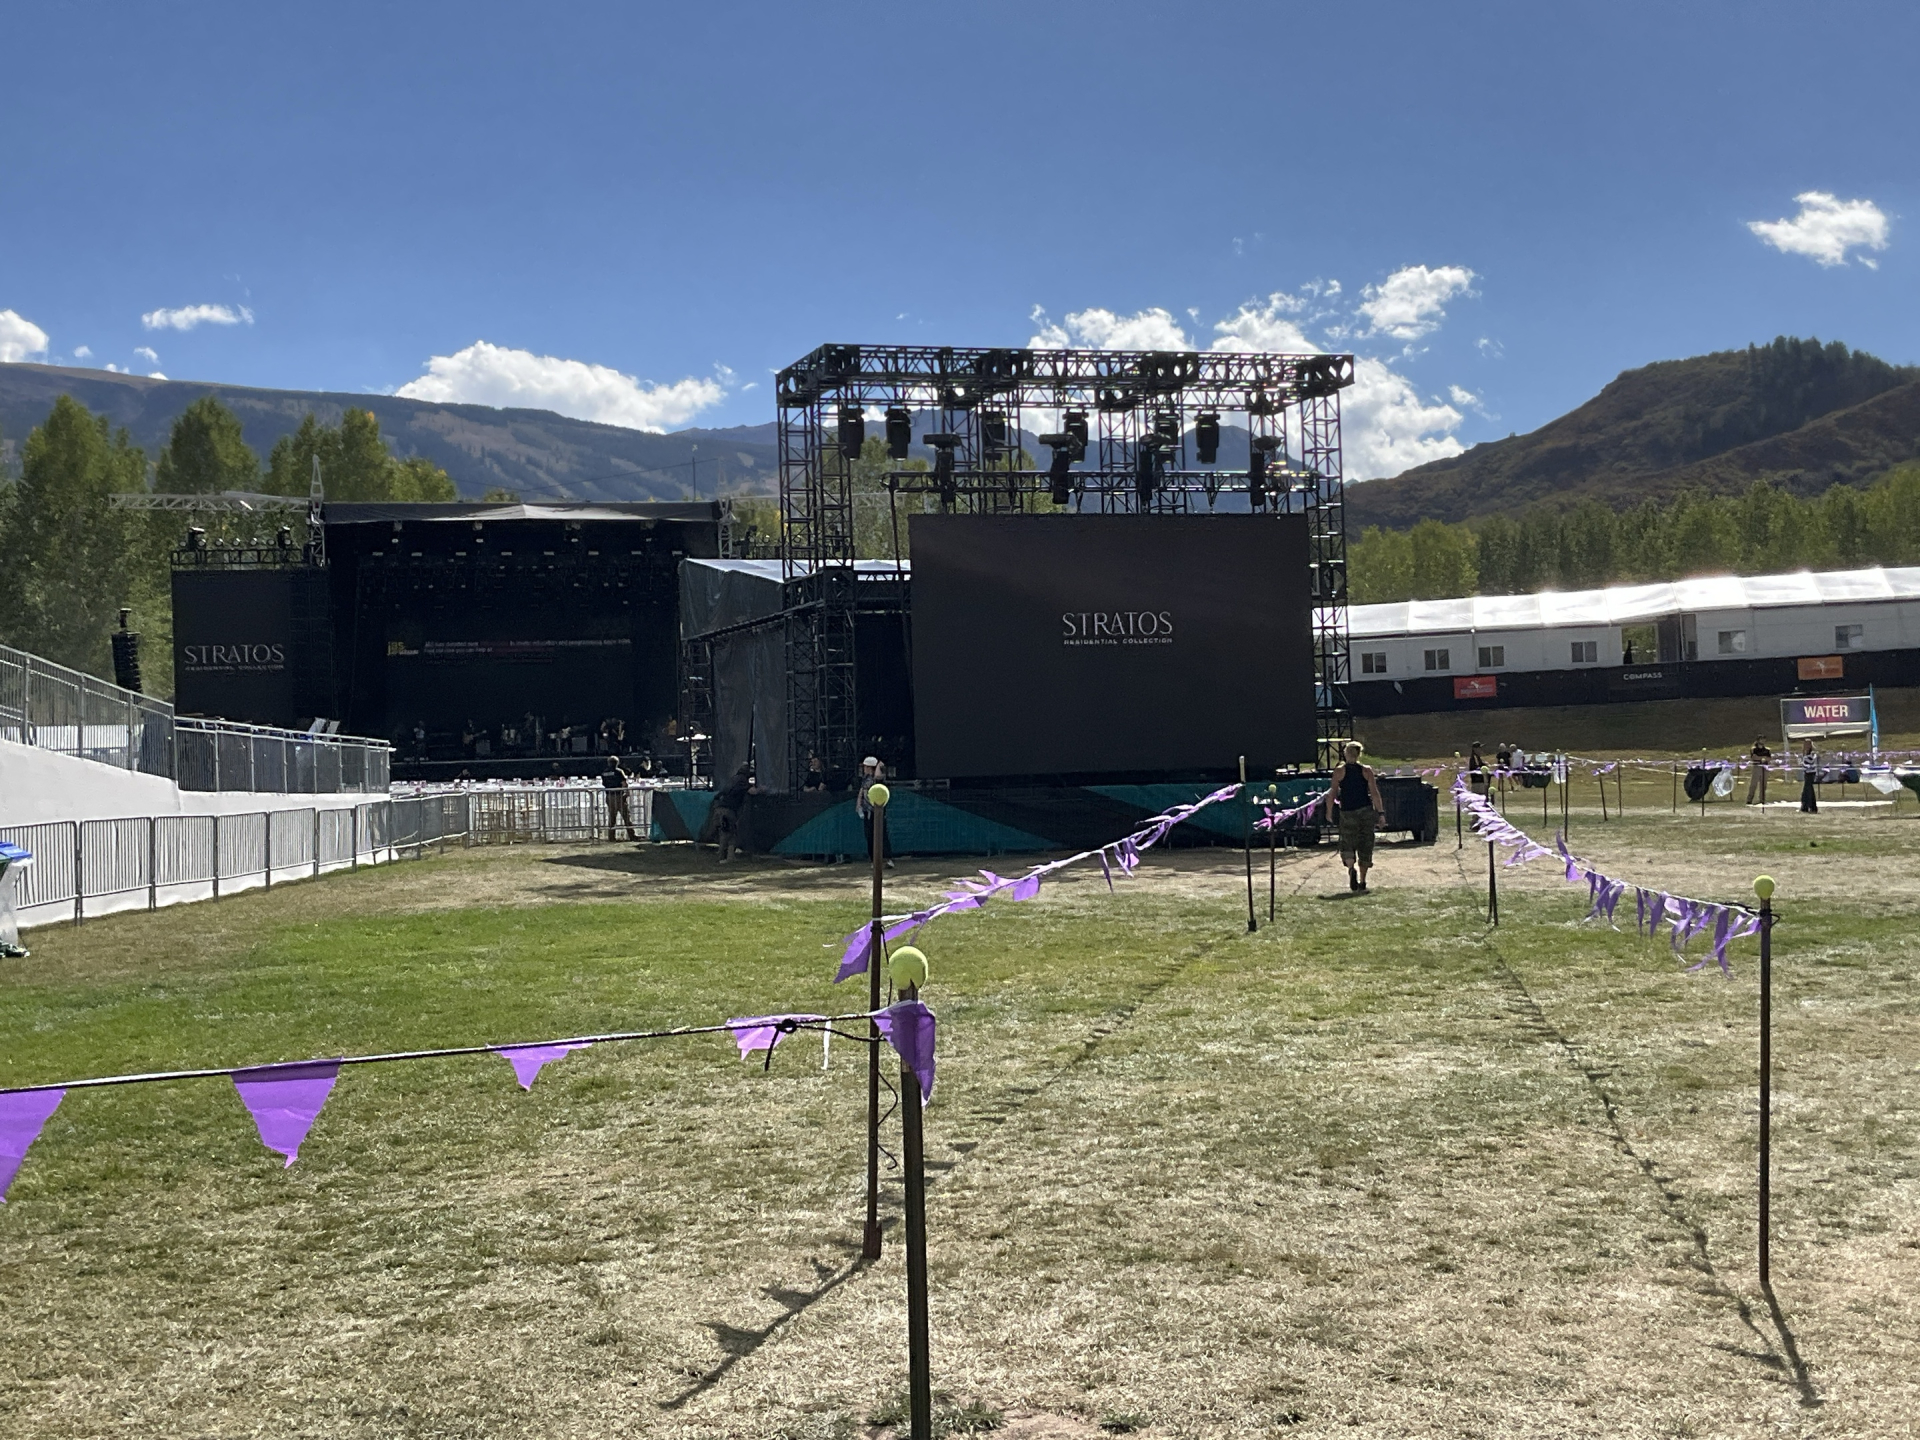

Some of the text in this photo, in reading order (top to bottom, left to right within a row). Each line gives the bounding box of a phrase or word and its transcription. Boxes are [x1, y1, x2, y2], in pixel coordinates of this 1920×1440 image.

[1062, 611, 1173, 636] STRATOS
[184, 643, 285, 664] STRATOS
[1623, 671, 1663, 681] COMPASS
[1803, 704, 1849, 719] WATER
